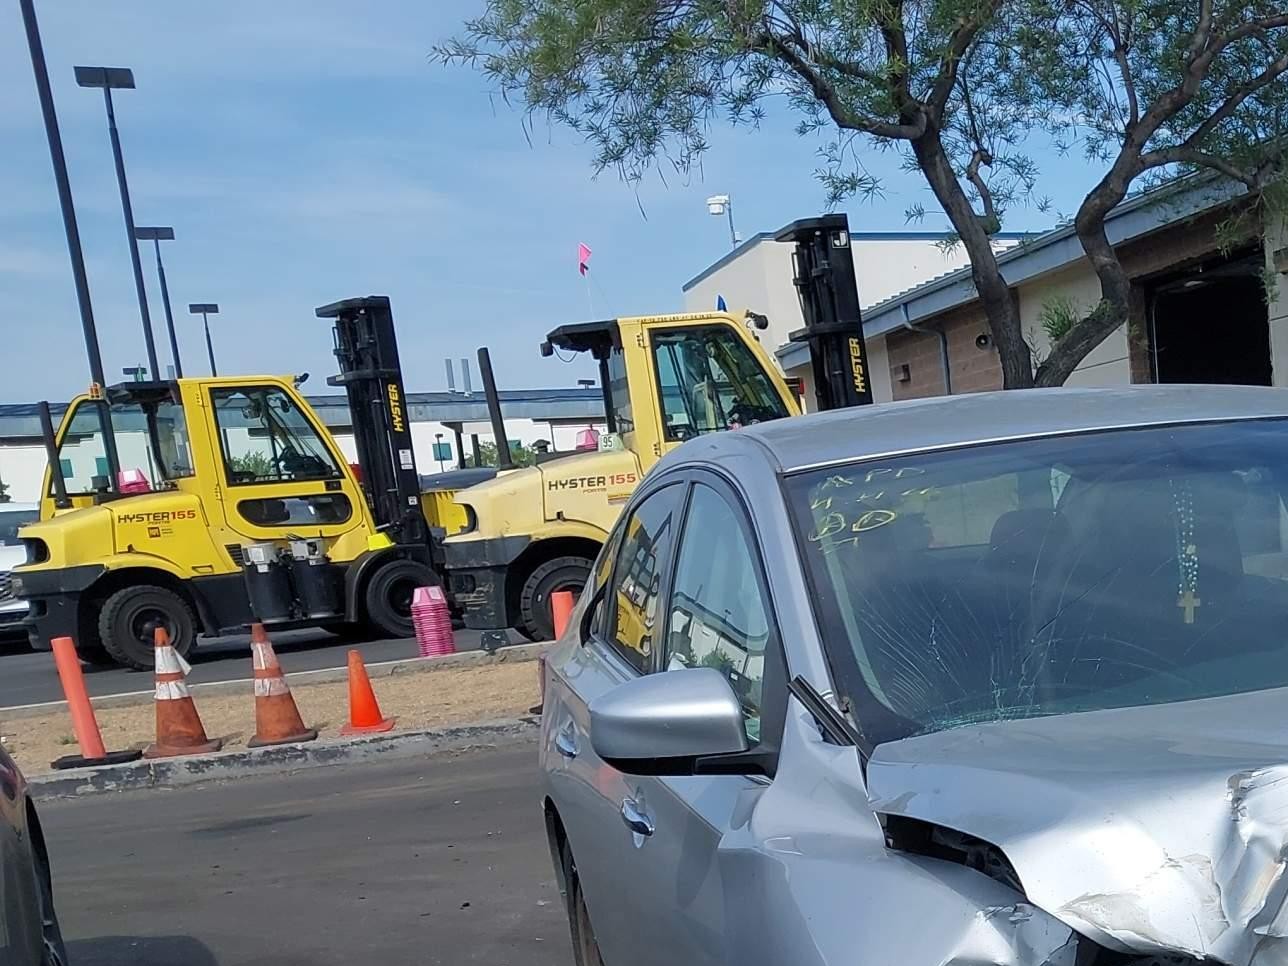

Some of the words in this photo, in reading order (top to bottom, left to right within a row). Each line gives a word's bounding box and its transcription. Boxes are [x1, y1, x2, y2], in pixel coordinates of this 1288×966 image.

[848, 337, 866, 393] HYSTER
[387, 383, 404, 432] HYSTER
[603, 436, 613, 448] 95
[548, 476, 607, 491] HYSTER
[608, 473, 637, 485] 155
[117, 511, 170, 524] HYSTER
[170, 509, 196, 520] 155
